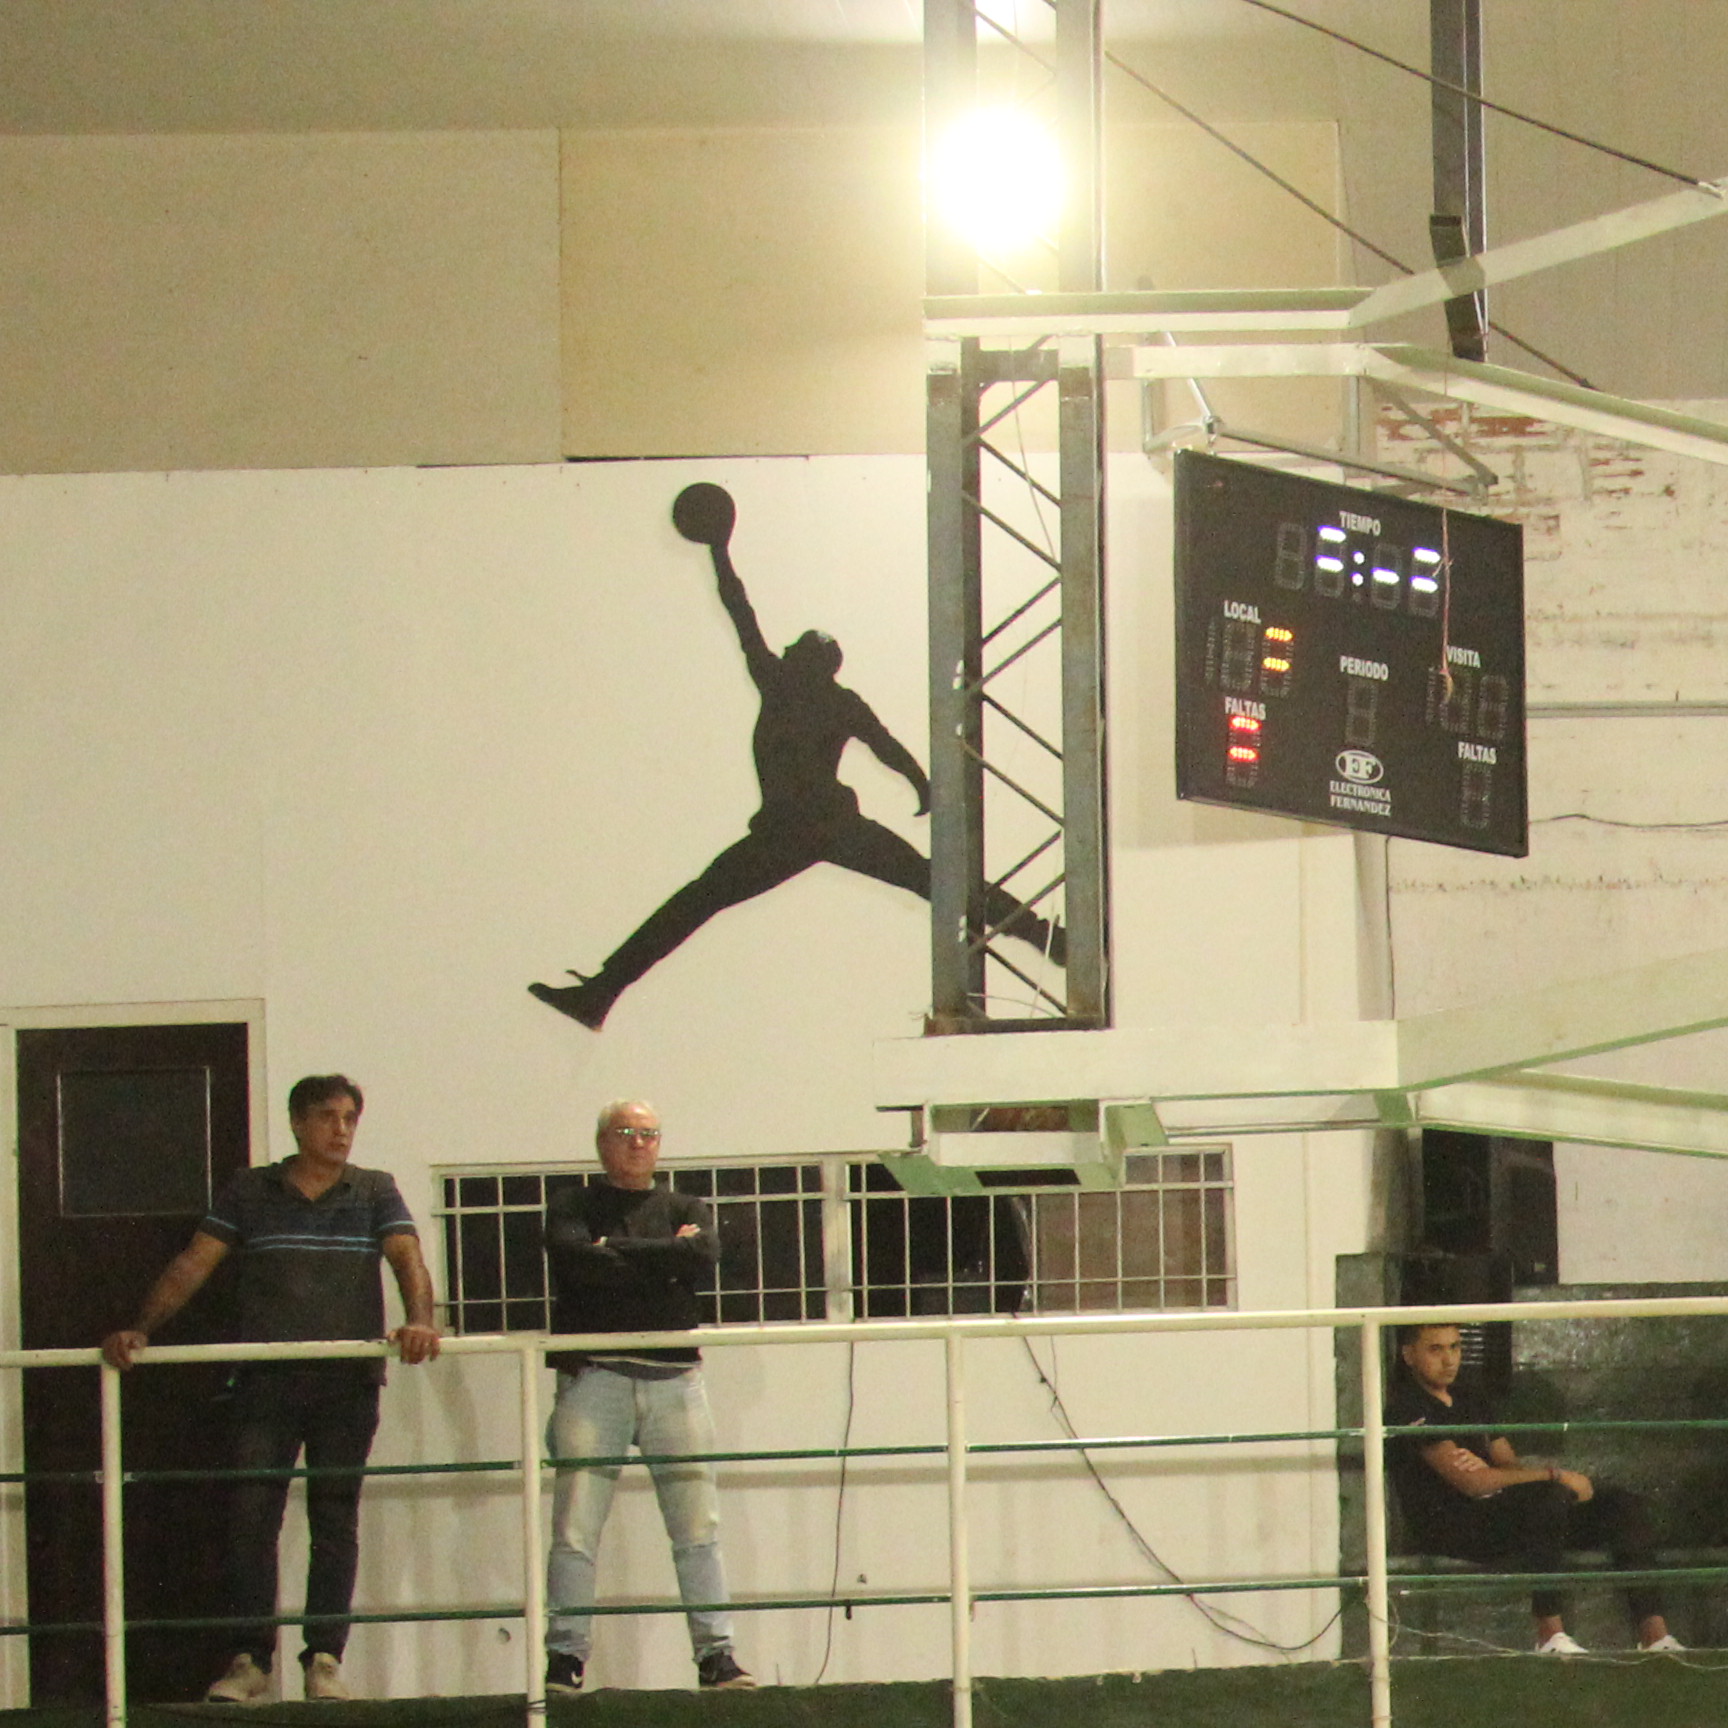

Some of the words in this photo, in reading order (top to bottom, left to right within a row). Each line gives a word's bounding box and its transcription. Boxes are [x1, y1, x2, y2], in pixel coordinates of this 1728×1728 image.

[1339, 511, 1381, 536] TIEMPO
[1223, 600, 1262, 624] LOCAL
[1339, 655, 1389, 681] PERIODO
[1446, 645, 1481, 668] VISITA
[1224, 696, 1267, 721] FALTAS
[1457, 741, 1497, 765] FALTAS
